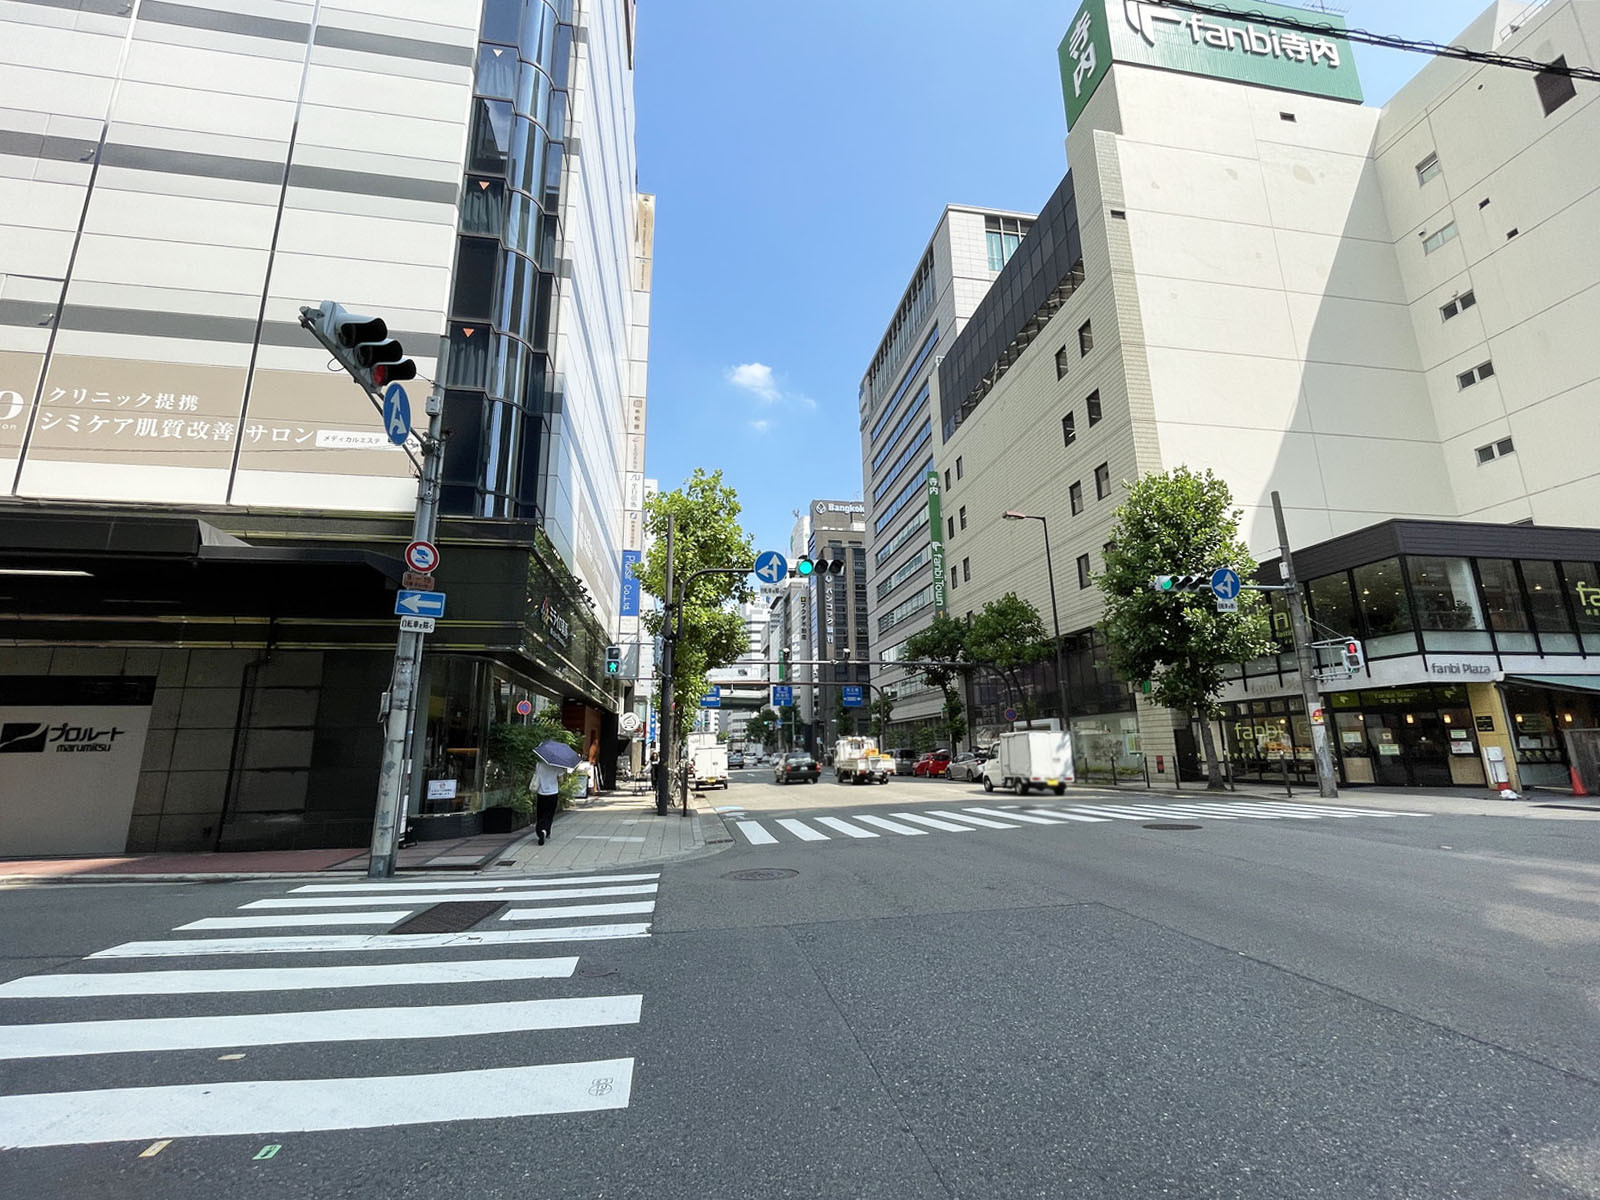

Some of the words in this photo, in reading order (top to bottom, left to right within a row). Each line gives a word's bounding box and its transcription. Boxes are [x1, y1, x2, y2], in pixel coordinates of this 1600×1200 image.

[1069, 10, 1097, 98] 寺内
[48, 387, 200, 411] クリニック提携
[934, 553, 944, 579] fanbi
[935, 580, 945, 606] Town
[1432, 663, 1460, 674] fanbi
[1462, 663, 1491, 675] Plaza
[49, 723, 126, 742] プロルート
[56, 743, 111, 753] marumitsu
